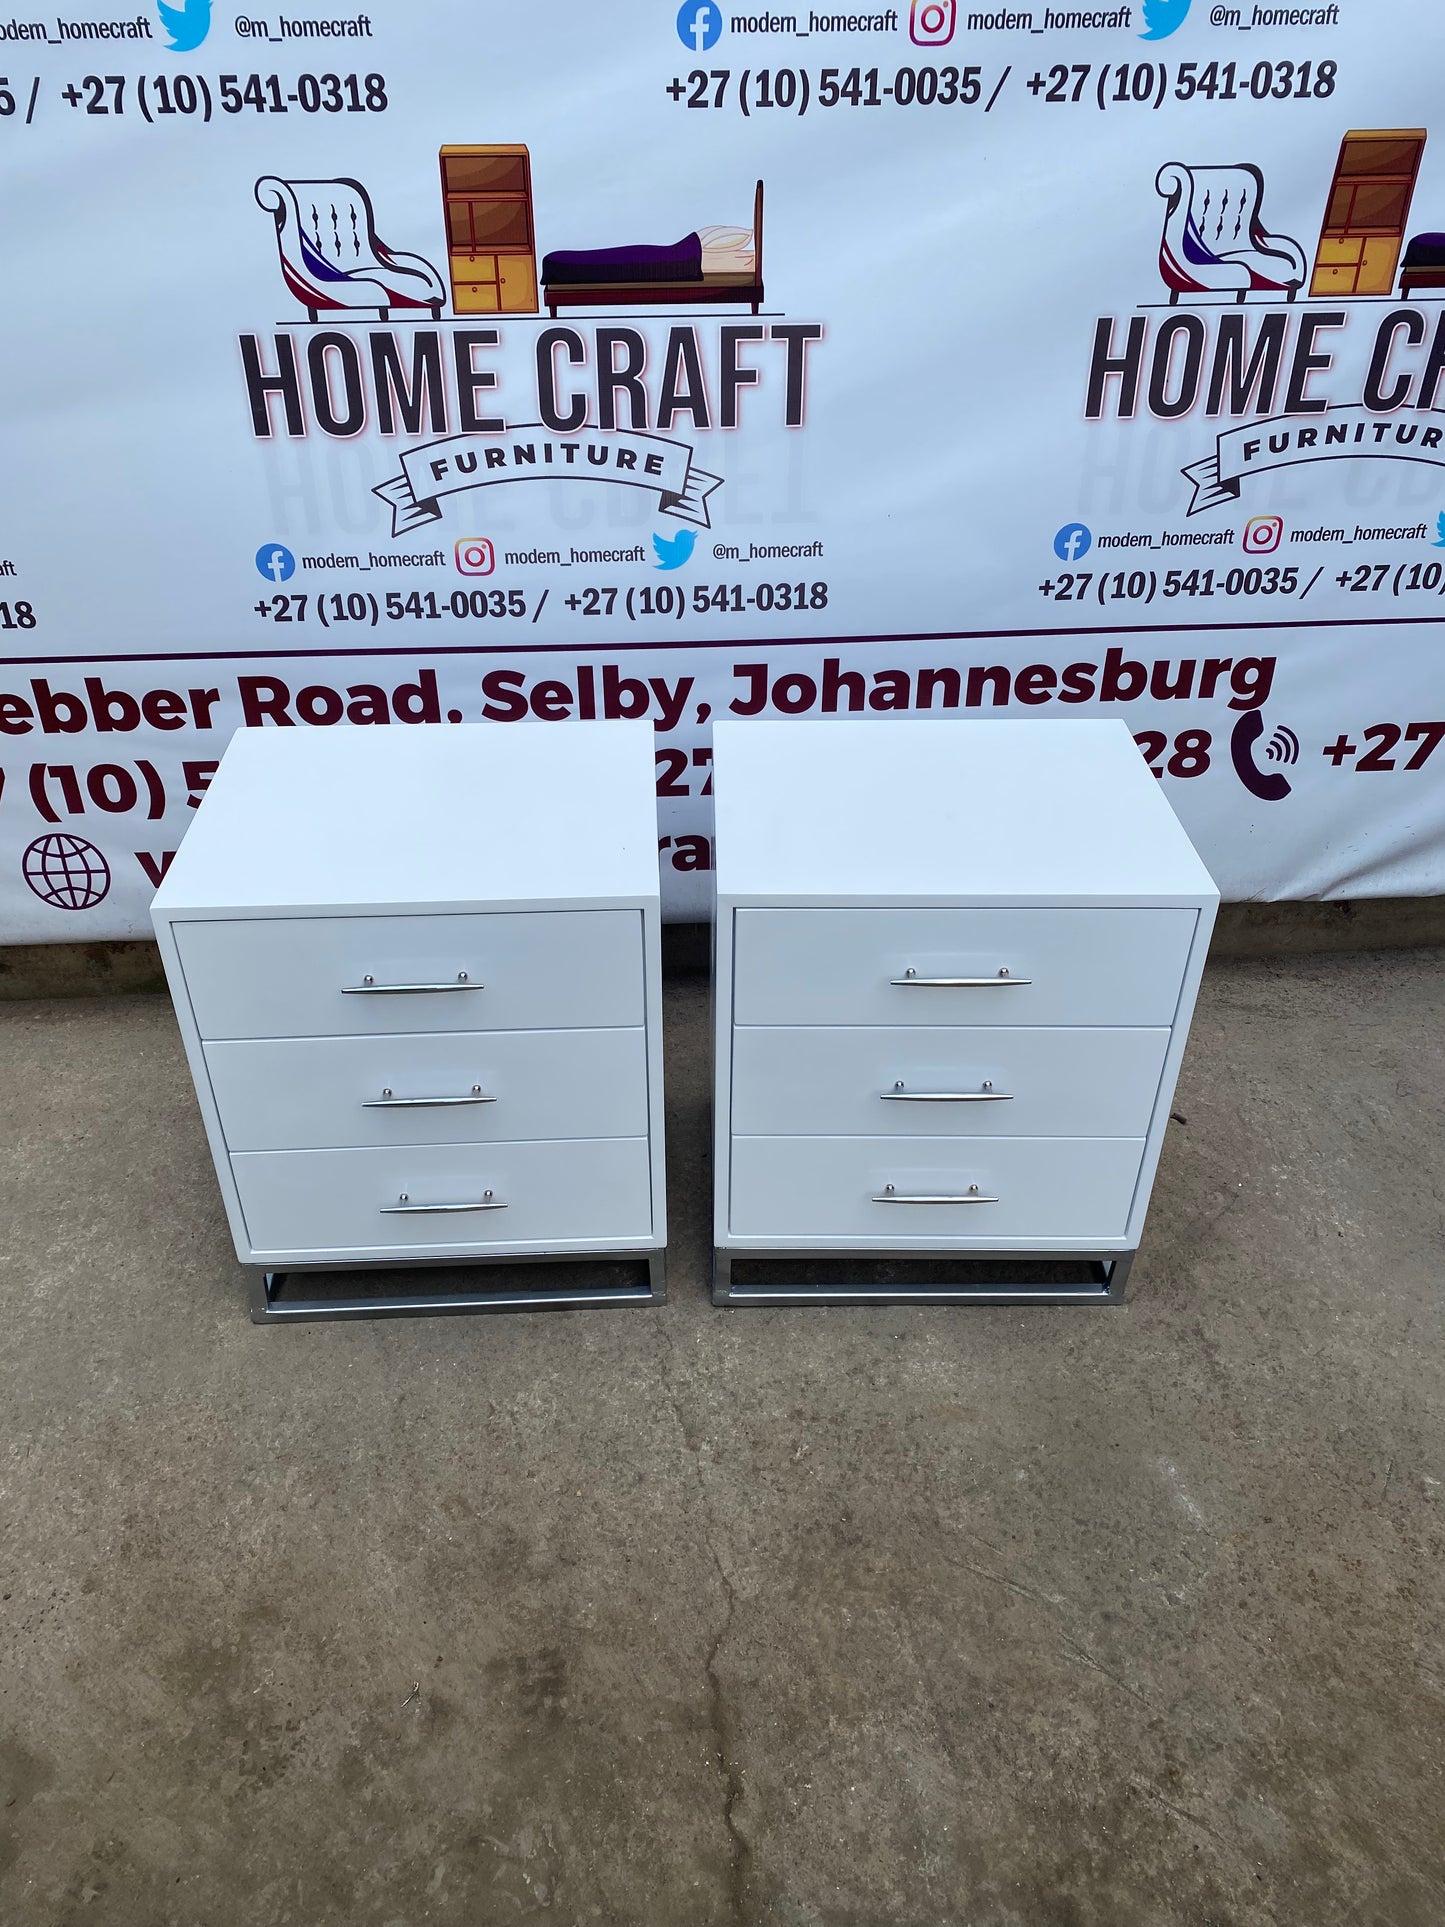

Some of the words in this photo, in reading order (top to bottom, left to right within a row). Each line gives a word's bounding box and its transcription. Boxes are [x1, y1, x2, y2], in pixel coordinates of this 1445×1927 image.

[235, 15, 373, 42] @m_homecraft
[1209, 4, 1340, 30] @m_homecraft
[61, 75, 126, 115] +27
[137, 74, 212, 123] (10)
[219, 73, 388, 114] 541-0318
[666, 69, 731, 109] +27
[739, 69, 810, 117] (10)
[818, 66, 982, 107] 541-0035
[1026, 64, 1092, 102] +27
[1096, 62, 1167, 110] (10)
[1174, 60, 1338, 101] 541-0318
[239, 331, 505, 437] HOME
[537, 324, 821, 433] CRAFT
[1085, 311, 1346, 419] HOME
[430, 442, 665, 481] FURNITURE
[1243, 422, 1443, 462] FURNITUR
[712, 541, 824, 562] @m_homecraft
[254, 594, 308, 622] +27
[317, 592, 379, 627] (10)
[386, 590, 527, 619] 541-0035
[564, 587, 618, 616] +27
[625, 585, 686, 621] (10)
[692, 582, 828, 613] 541-0318
[1038, 573, 1094, 601] +27
[1098, 570, 1157, 605] (10)
[1162, 567, 1299, 598] 541-0035
[1335, 565, 1391, 592] +27
[481, 664, 712, 732] Selby,
[728, 647, 1278, 711] Johannesburg
[29, 760, 166, 823] (10)
[1322, 721, 1445, 772] +27
